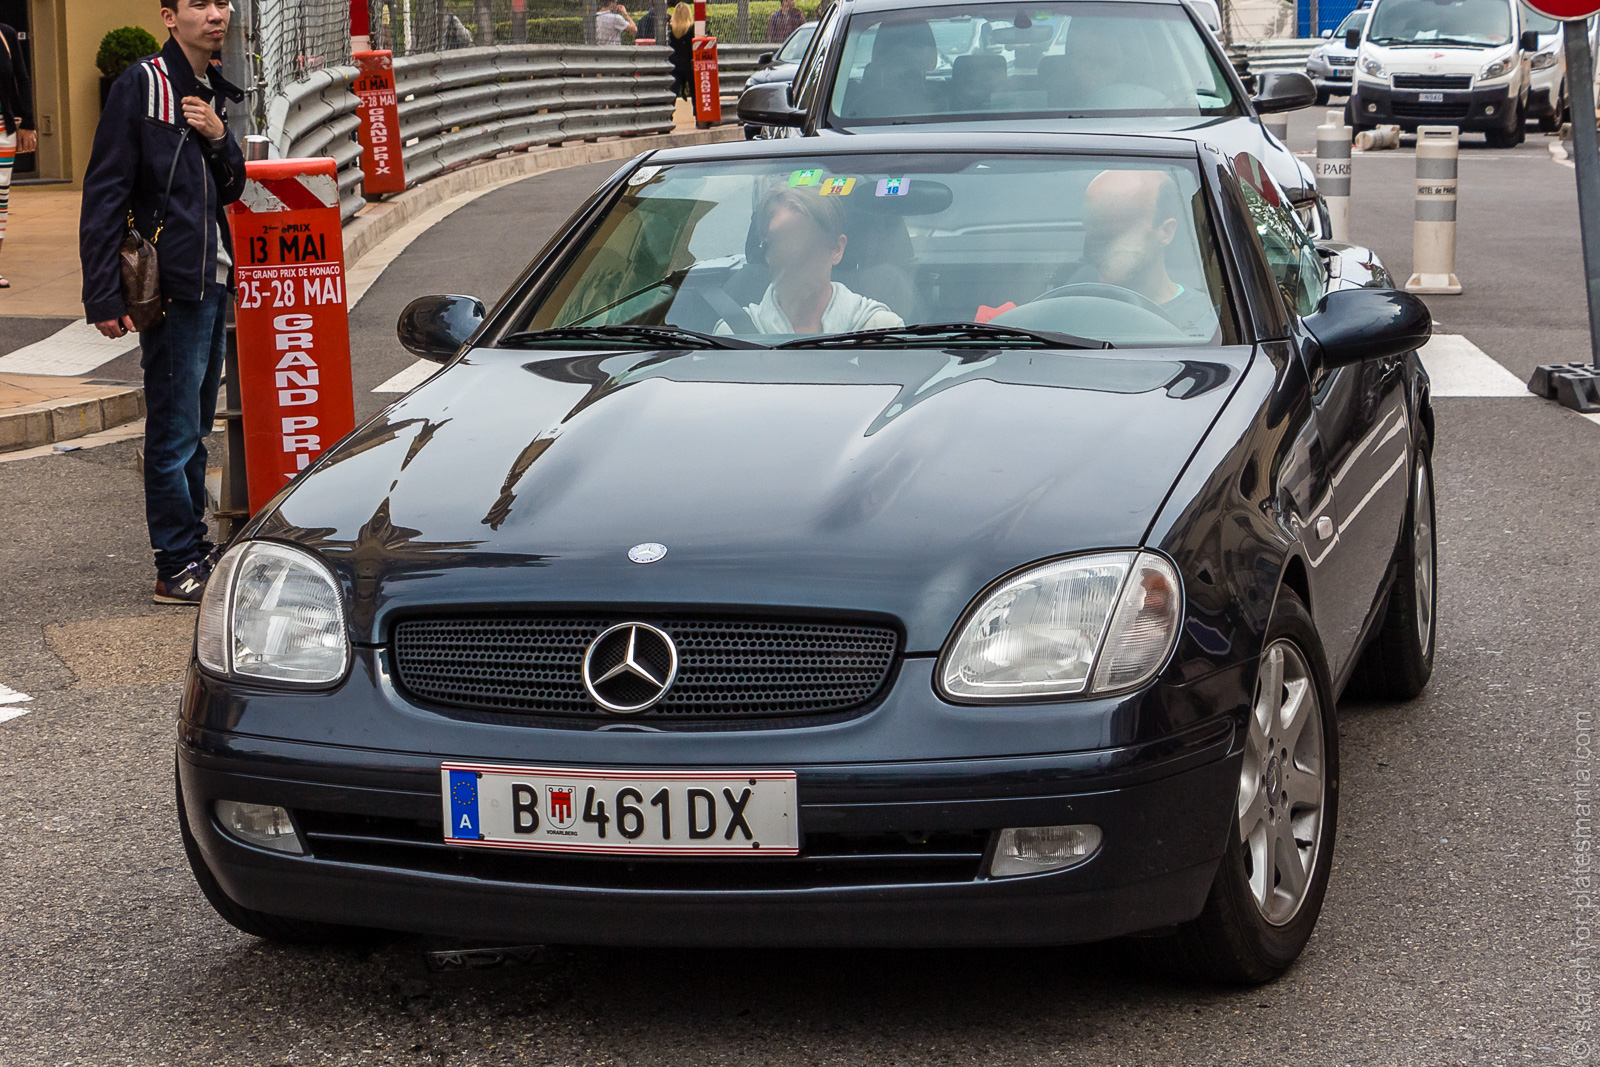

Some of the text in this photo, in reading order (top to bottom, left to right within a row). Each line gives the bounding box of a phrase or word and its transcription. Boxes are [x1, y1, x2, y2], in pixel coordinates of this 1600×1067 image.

[370, 78, 388, 90] MAI
[358, 96, 378, 108] 5-28
[379, 94, 395, 107] MAI
[368, 108, 388, 144] GRAND
[373, 146, 391, 175] PRIX
[830, 186, 843, 194] 15
[886, 186, 899, 194] 16
[281, 223, 311, 233] ePRIX
[250, 233, 326, 263] 13 MAI
[252, 269, 278, 279] GRAND
[280, 269, 296, 278] PRIX
[298, 268, 308, 276] DE
[309, 265, 340, 276] MONACO
[239, 276, 342, 309] 25-28 MAI
[273, 313, 320, 407] GRAND
[180, 578, 200, 594] N
[511, 782, 540, 834] B
[459, 814, 472, 830] A
